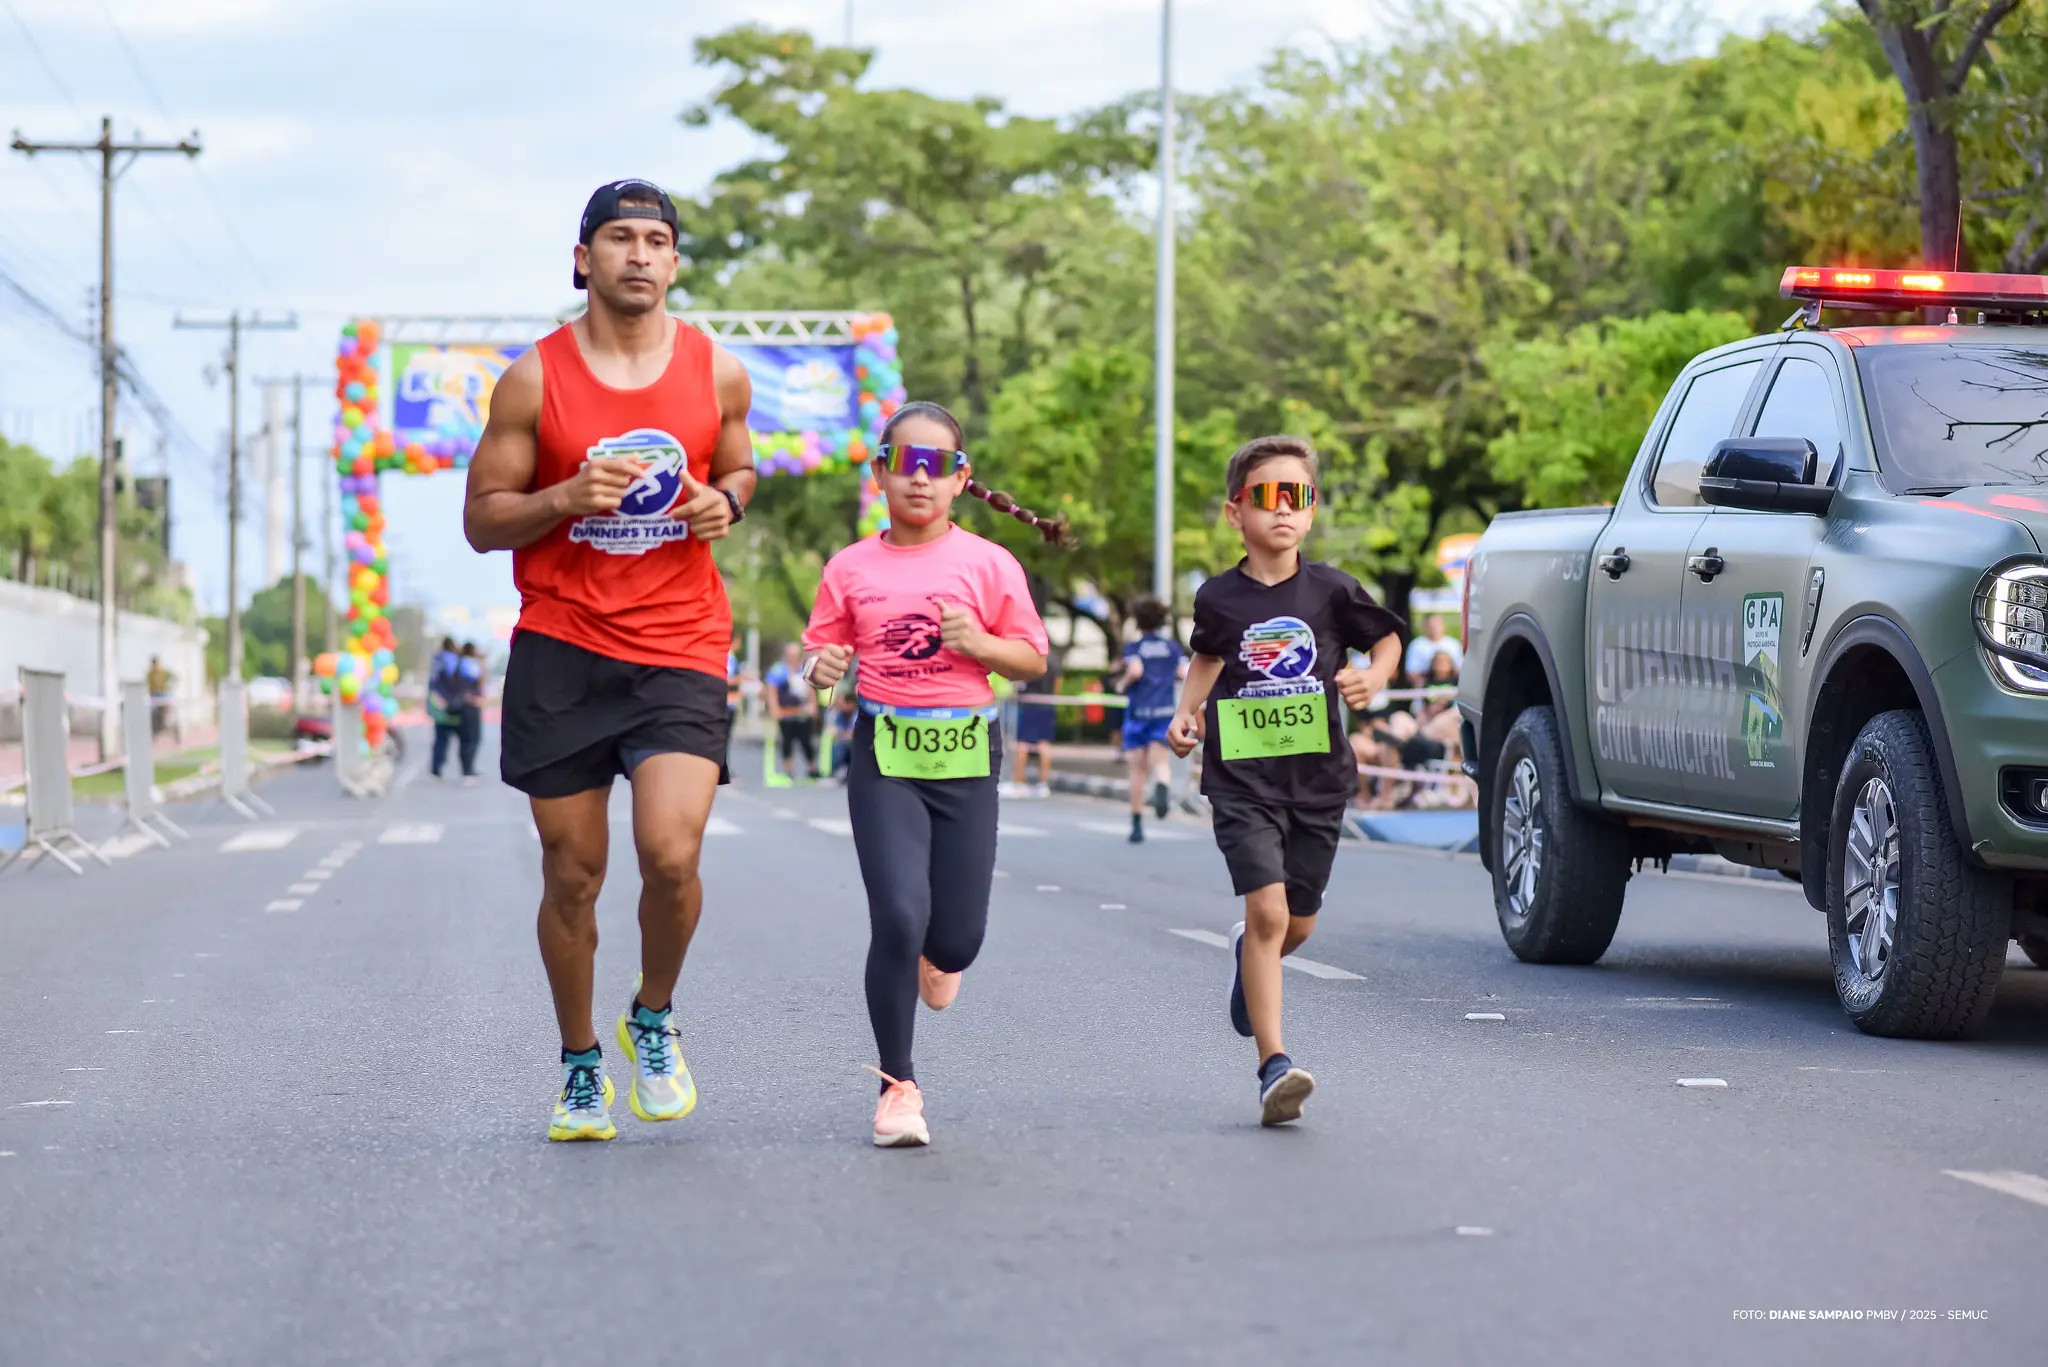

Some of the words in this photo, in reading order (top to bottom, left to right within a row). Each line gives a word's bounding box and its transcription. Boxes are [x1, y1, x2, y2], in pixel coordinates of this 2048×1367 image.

[572, 526, 639, 539] RUNNERS
[644, 524, 684, 538] TEAM
[1238, 703, 1315, 729] 10453
[887, 725, 977, 753] 10336
[1597, 705, 1638, 764] CIVIL
[1639, 712, 1736, 780] MUNICIPAL
